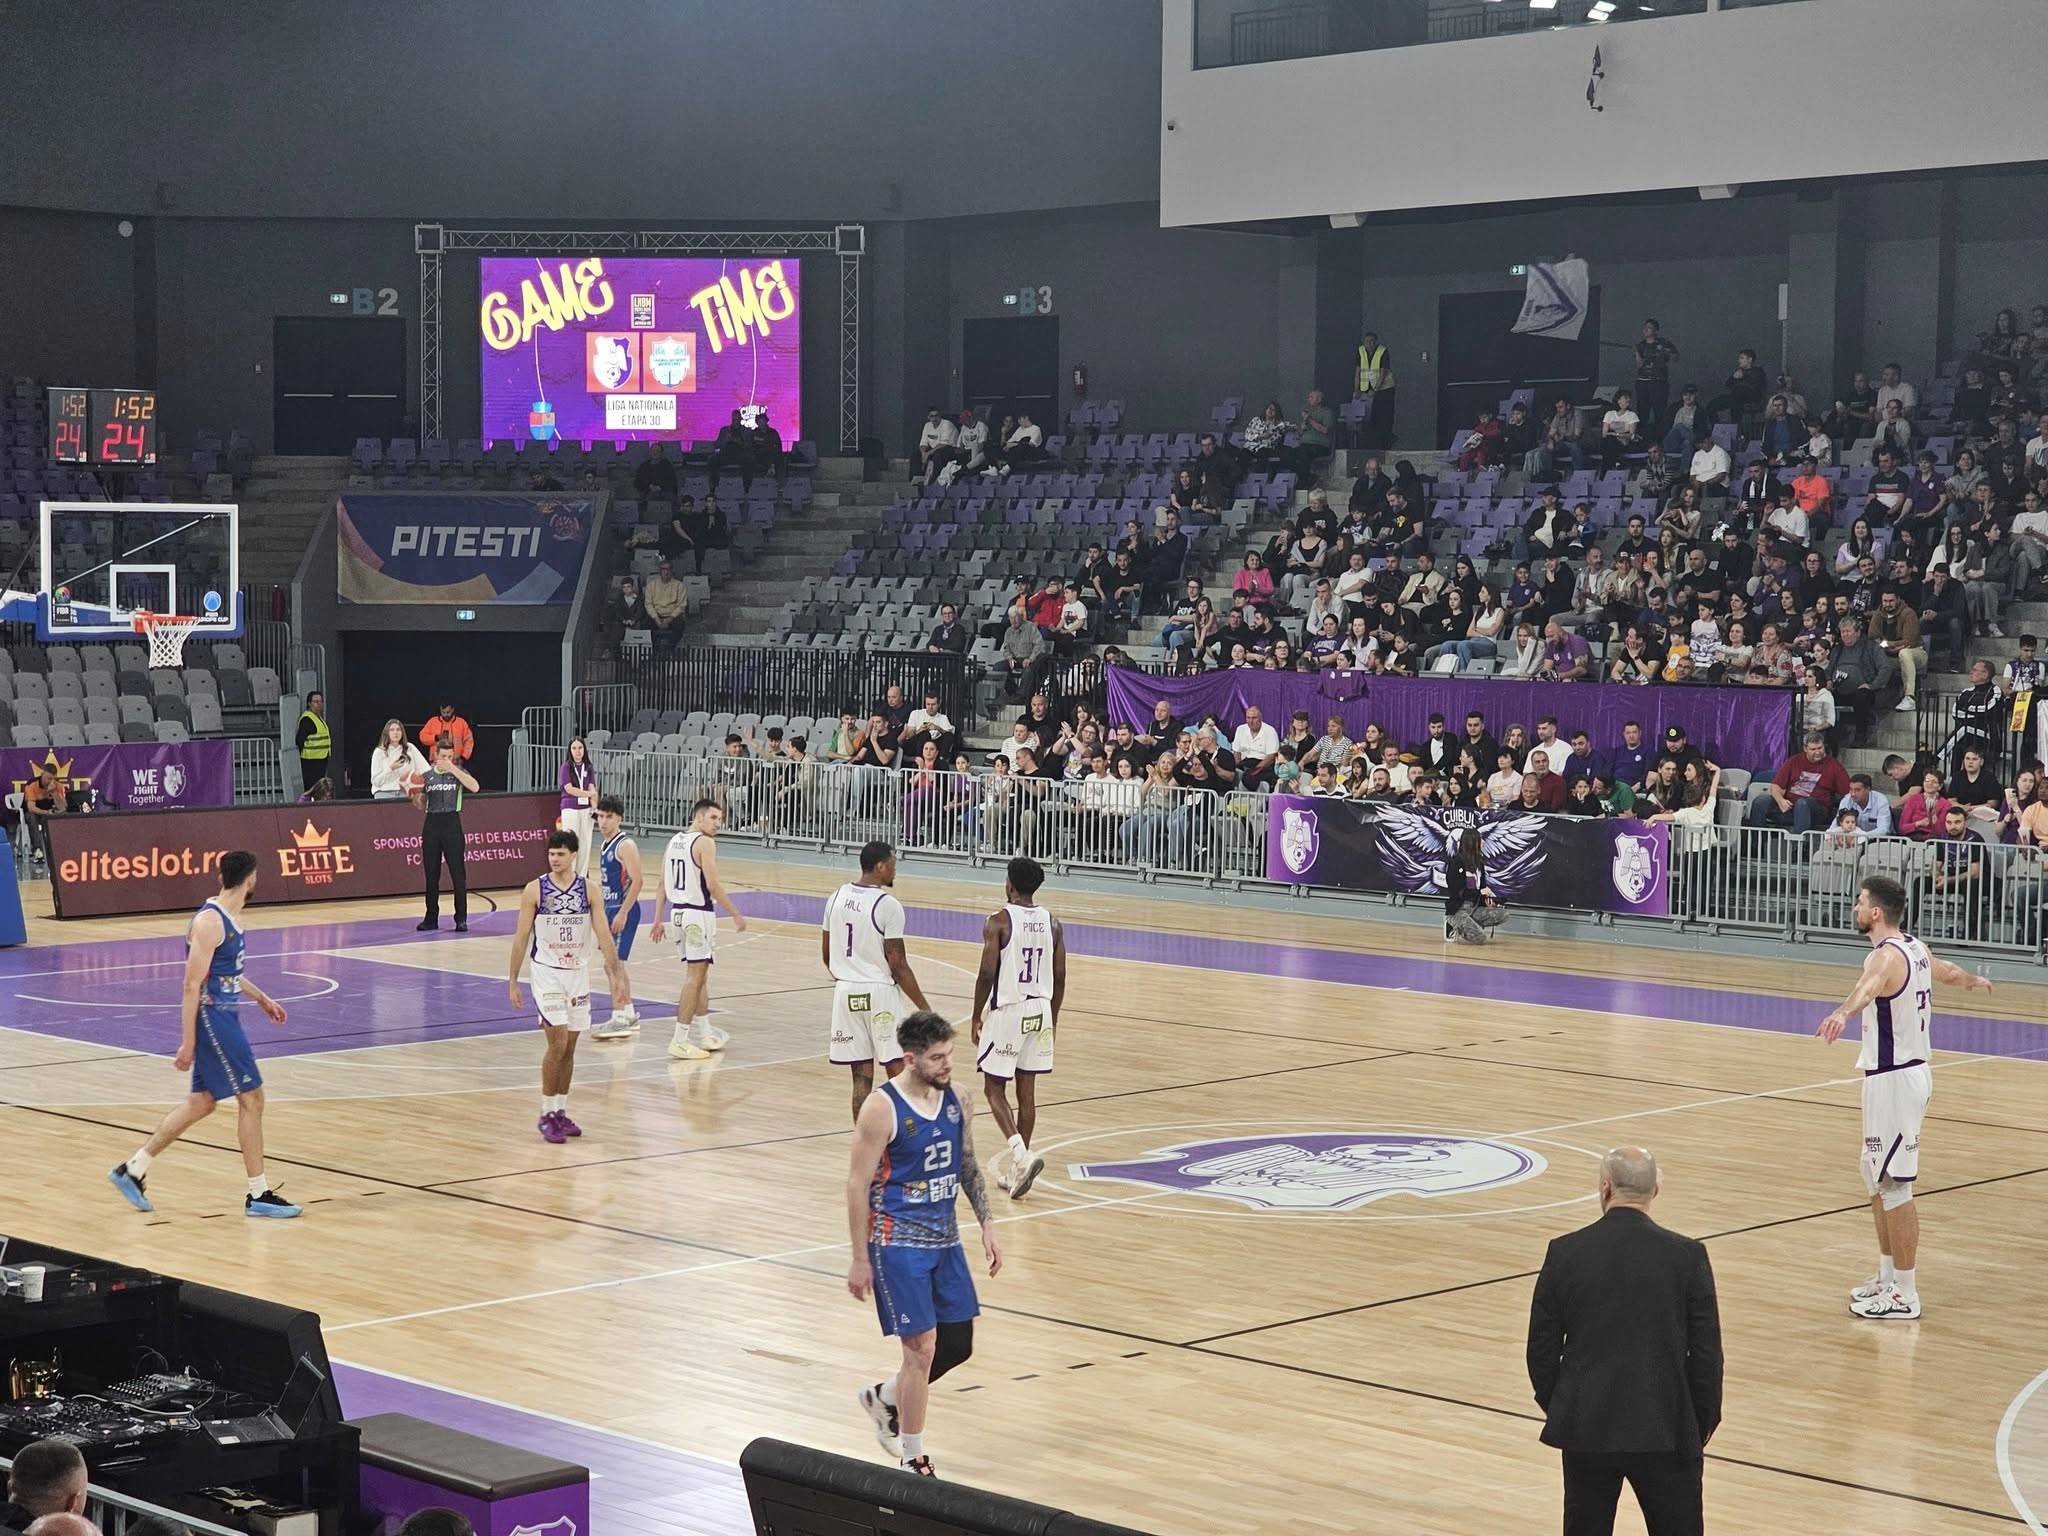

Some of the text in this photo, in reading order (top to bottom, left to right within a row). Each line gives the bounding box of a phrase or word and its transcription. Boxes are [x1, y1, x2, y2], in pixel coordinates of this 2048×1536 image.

[353, 288, 398, 315] B2
[481, 257, 614, 350] GAME
[690, 260, 795, 353] TIME
[1020, 286, 1052, 313] B3
[62, 395, 86, 416] 1:52
[115, 396, 154, 419] 1:52
[607, 400, 626, 411] LIGA
[621, 415, 661, 426] ETAPA 30
[56, 422, 81, 456] 24
[102, 423, 145, 459] 24
[391, 526, 541, 557] PITESTI
[132, 768, 158, 785] WE
[128, 794, 165, 806] Together
[134, 786, 158, 795] FIGHT
[1443, 809, 1477, 828] CUIBUL
[487, 831, 500, 843] DE
[502, 829, 548, 842] BASCHET
[277, 846, 354, 877] ELITE
[407, 854, 421, 866] FC
[305, 874, 333, 885] SLOTS
[671, 859, 686, 891] 10
[844, 899, 861, 913] HILL
[559, 927, 573, 942] 28
[845, 922, 854, 957] 1
[1018, 948, 1043, 984] 31
[924, 1140, 953, 1172] 23
